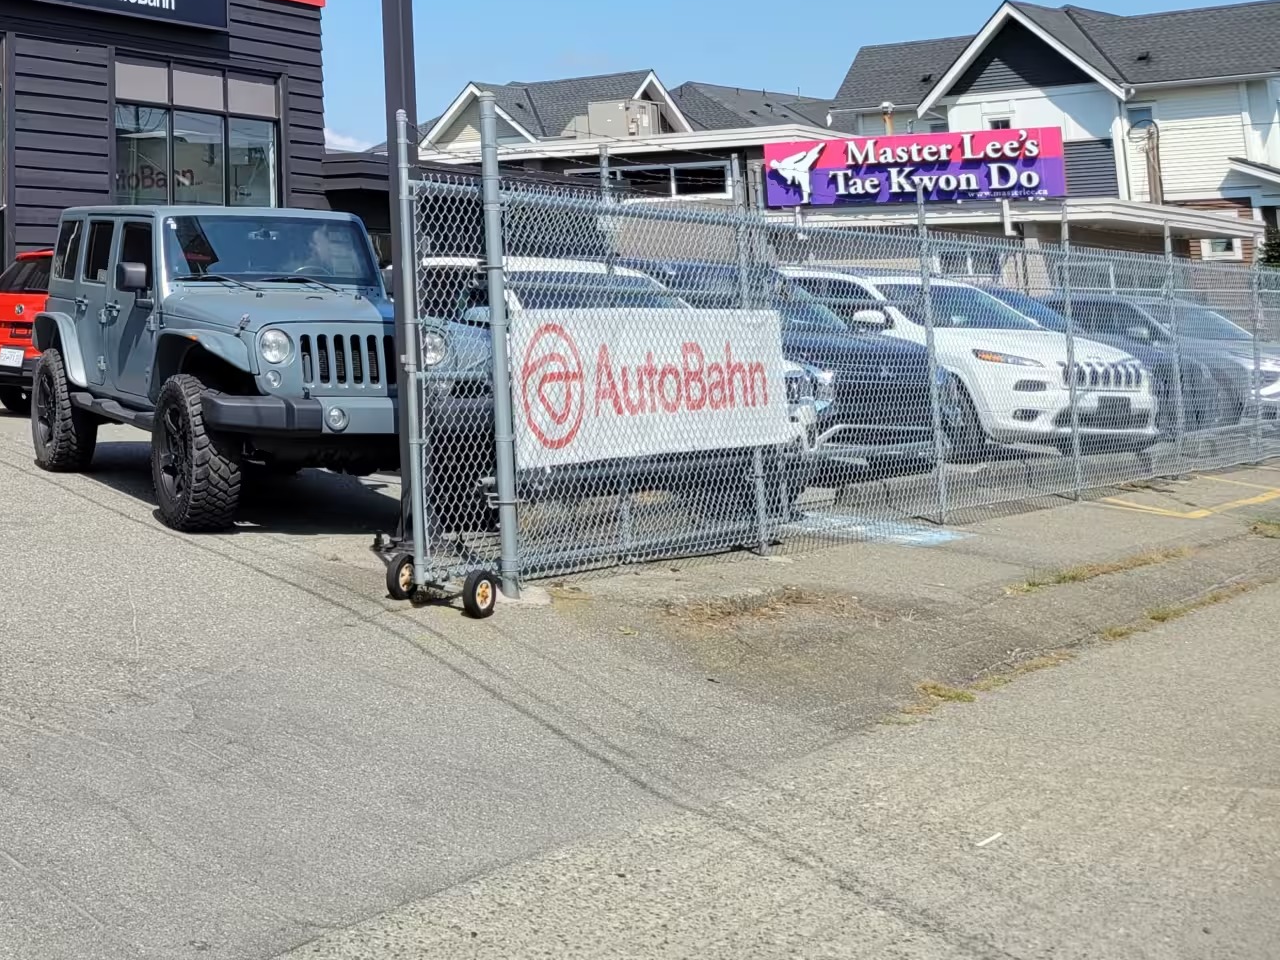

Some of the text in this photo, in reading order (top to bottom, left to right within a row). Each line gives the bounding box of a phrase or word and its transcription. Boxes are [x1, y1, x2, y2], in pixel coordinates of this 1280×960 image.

[845, 130, 1040, 166] Master Lee's
[829, 162, 1040, 196] Tae Kwon Do
[594, 340, 768, 417] AutoBahn
